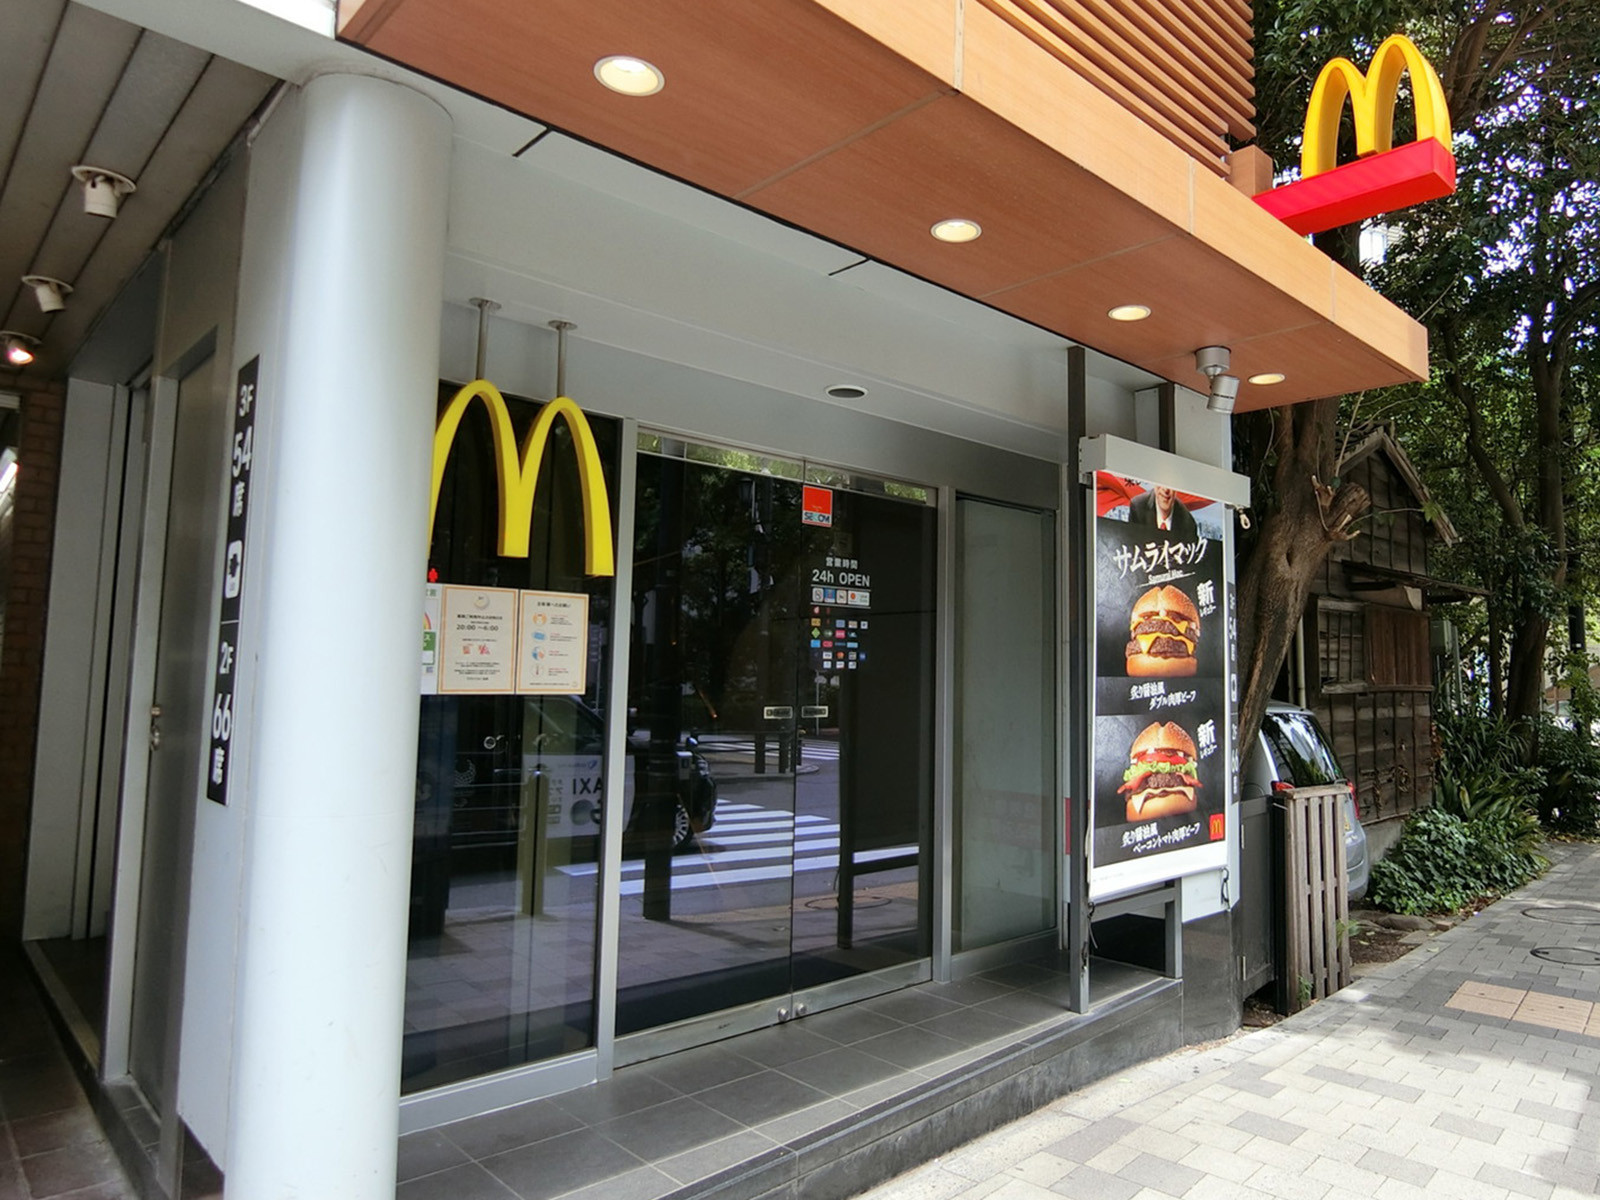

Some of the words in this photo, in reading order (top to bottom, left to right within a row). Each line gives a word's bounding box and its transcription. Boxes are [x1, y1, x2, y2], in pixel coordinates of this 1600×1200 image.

[239, 384, 255, 418] 3F
[825, 557, 858, 570] 営業時間
[1113, 537, 1208, 579] サムライマック
[811, 569, 834, 583] 24h
[838, 572, 871, 587] OPEN
[1197, 580, 1214, 606] 新
[219, 641, 234, 675] 2F
[1197, 719, 1216, 749] 新
